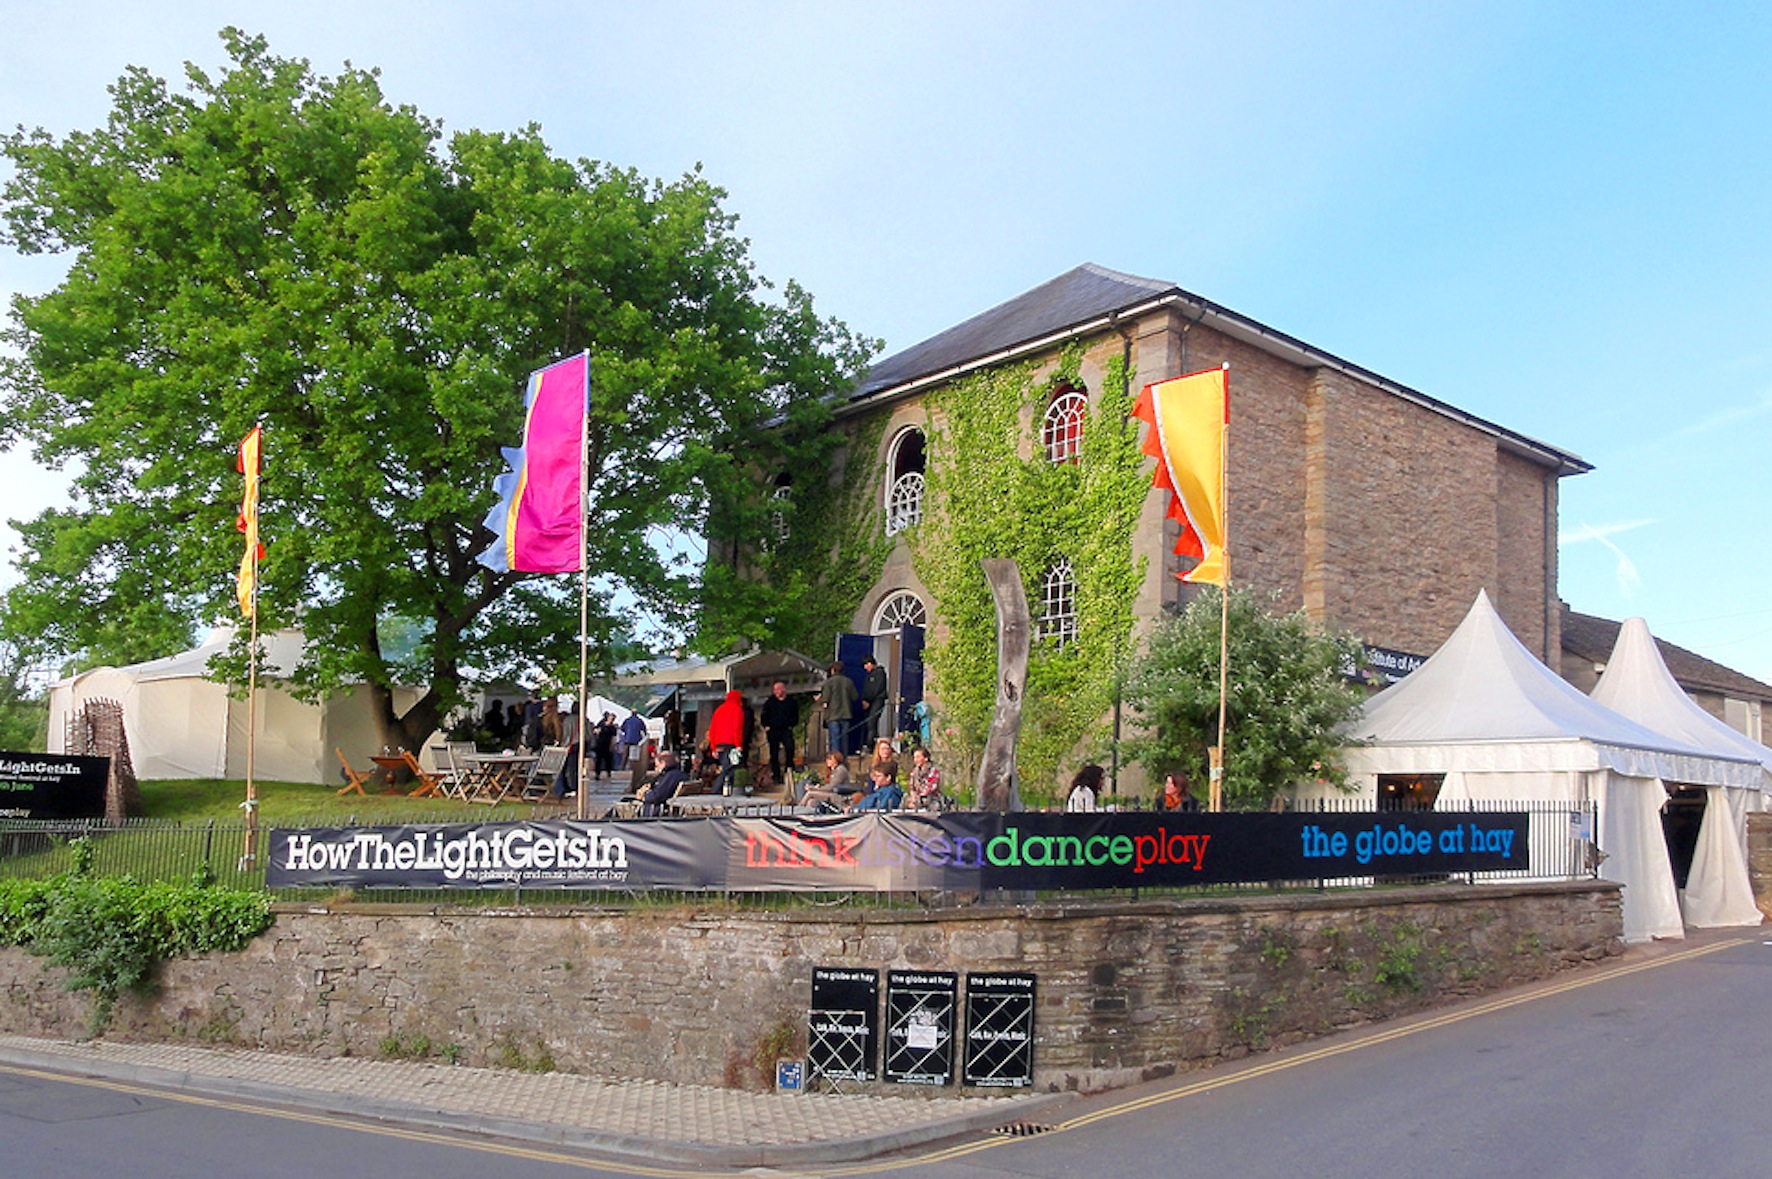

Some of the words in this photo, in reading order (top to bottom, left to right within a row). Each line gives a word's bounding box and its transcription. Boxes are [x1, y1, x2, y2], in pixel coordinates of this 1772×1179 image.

[1302, 825, 1347, 857] the
[1355, 824, 1432, 864] globe
[1438, 824, 1464, 853] at
[1470, 824, 1514, 858] hay
[285, 829, 628, 879] HowTheLightGetsIn
[465, 870, 478, 879] the
[522, 870, 541, 879] and
[541, 870, 566, 879] music
[598, 870, 608, 879] at
[609, 870, 628, 881] hay
[891, 974, 904, 983] the
[905, 975, 928, 985] globe
[928, 976, 937, 984] at
[937, 975, 954, 985] hay
[970, 977, 983, 985] the
[984, 977, 1007, 987] globe
[1008, 978, 1016, 986] at
[1017, 978, 1033, 987] hay
